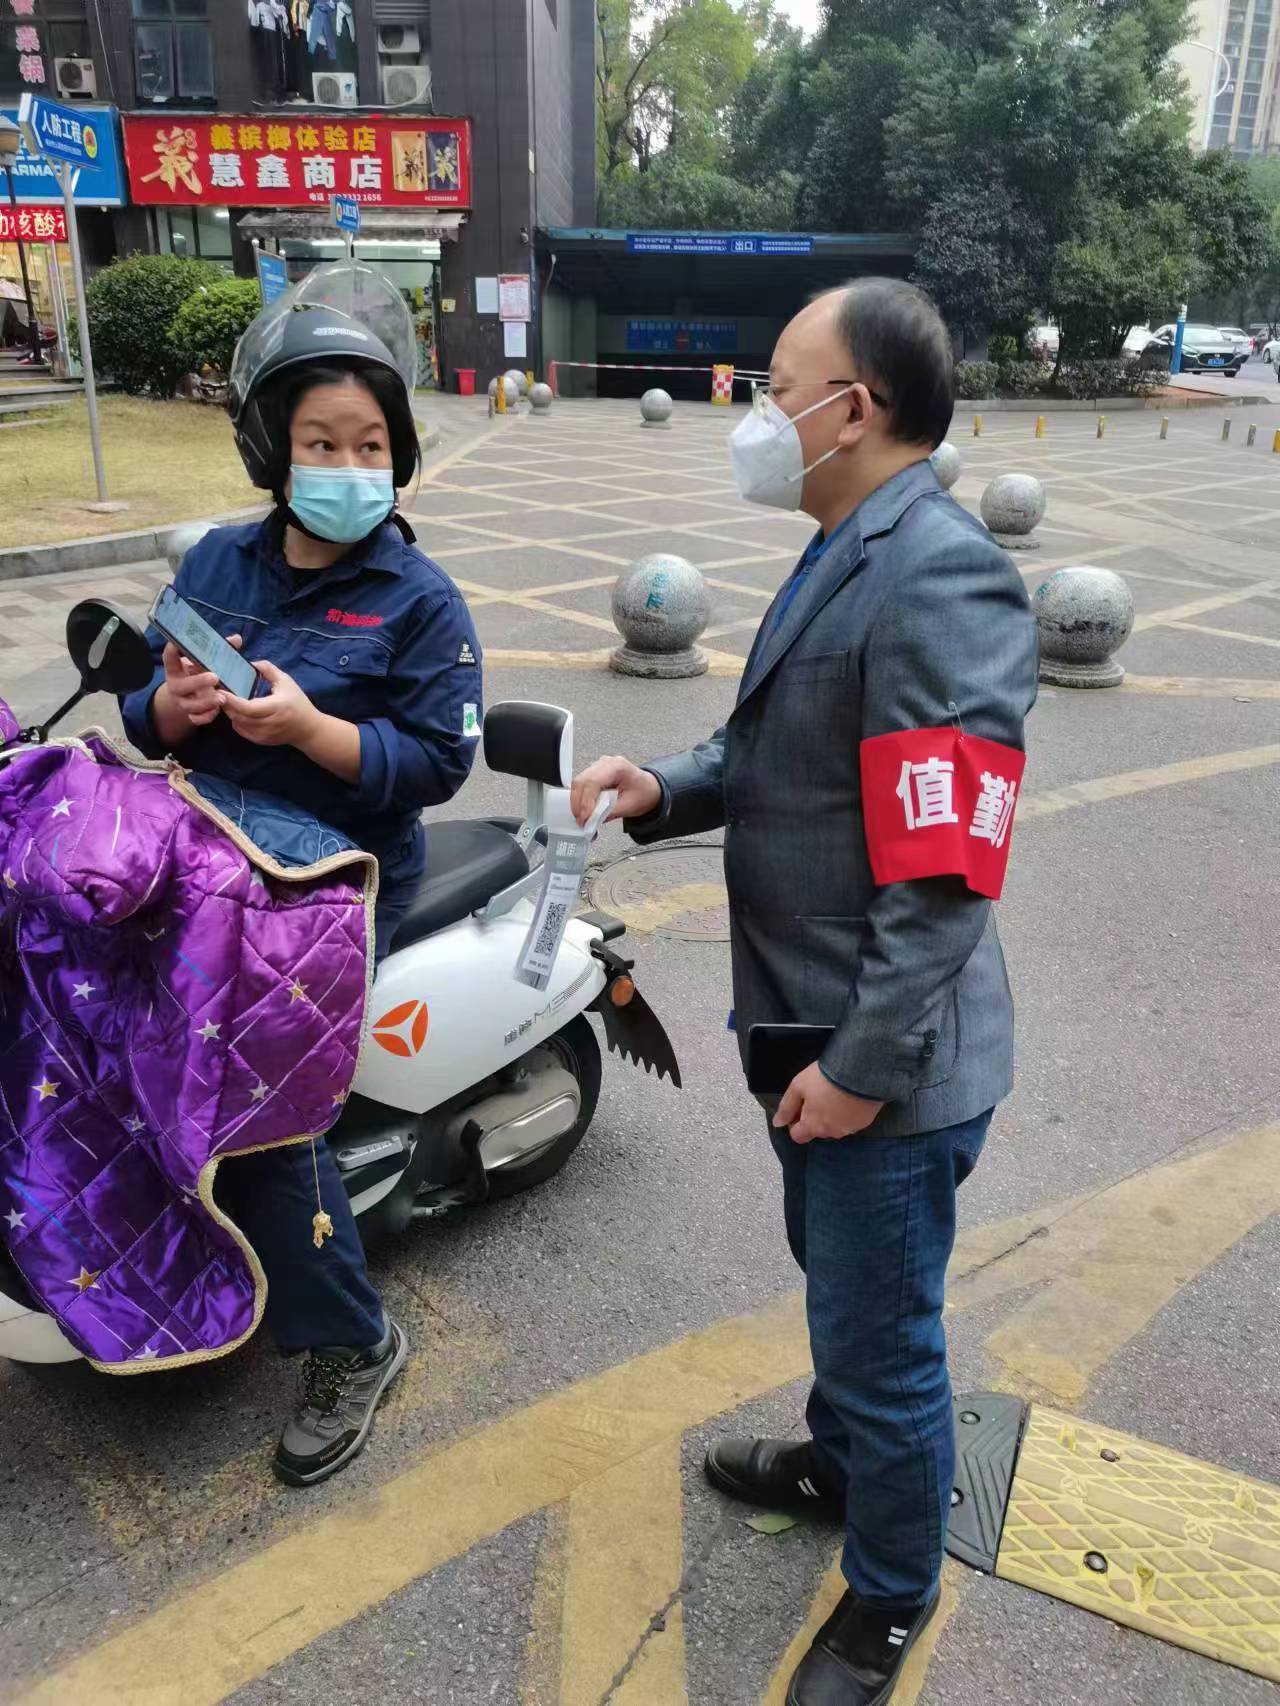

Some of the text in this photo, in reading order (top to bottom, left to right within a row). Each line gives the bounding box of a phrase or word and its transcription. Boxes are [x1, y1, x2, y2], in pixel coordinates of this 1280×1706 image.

[42, 110, 82, 144] 人防工程
[209, 152, 382, 189] 慧鑫商店
[735, 241, 754, 252] 出口
[896, 757, 1016, 848] 值勤
